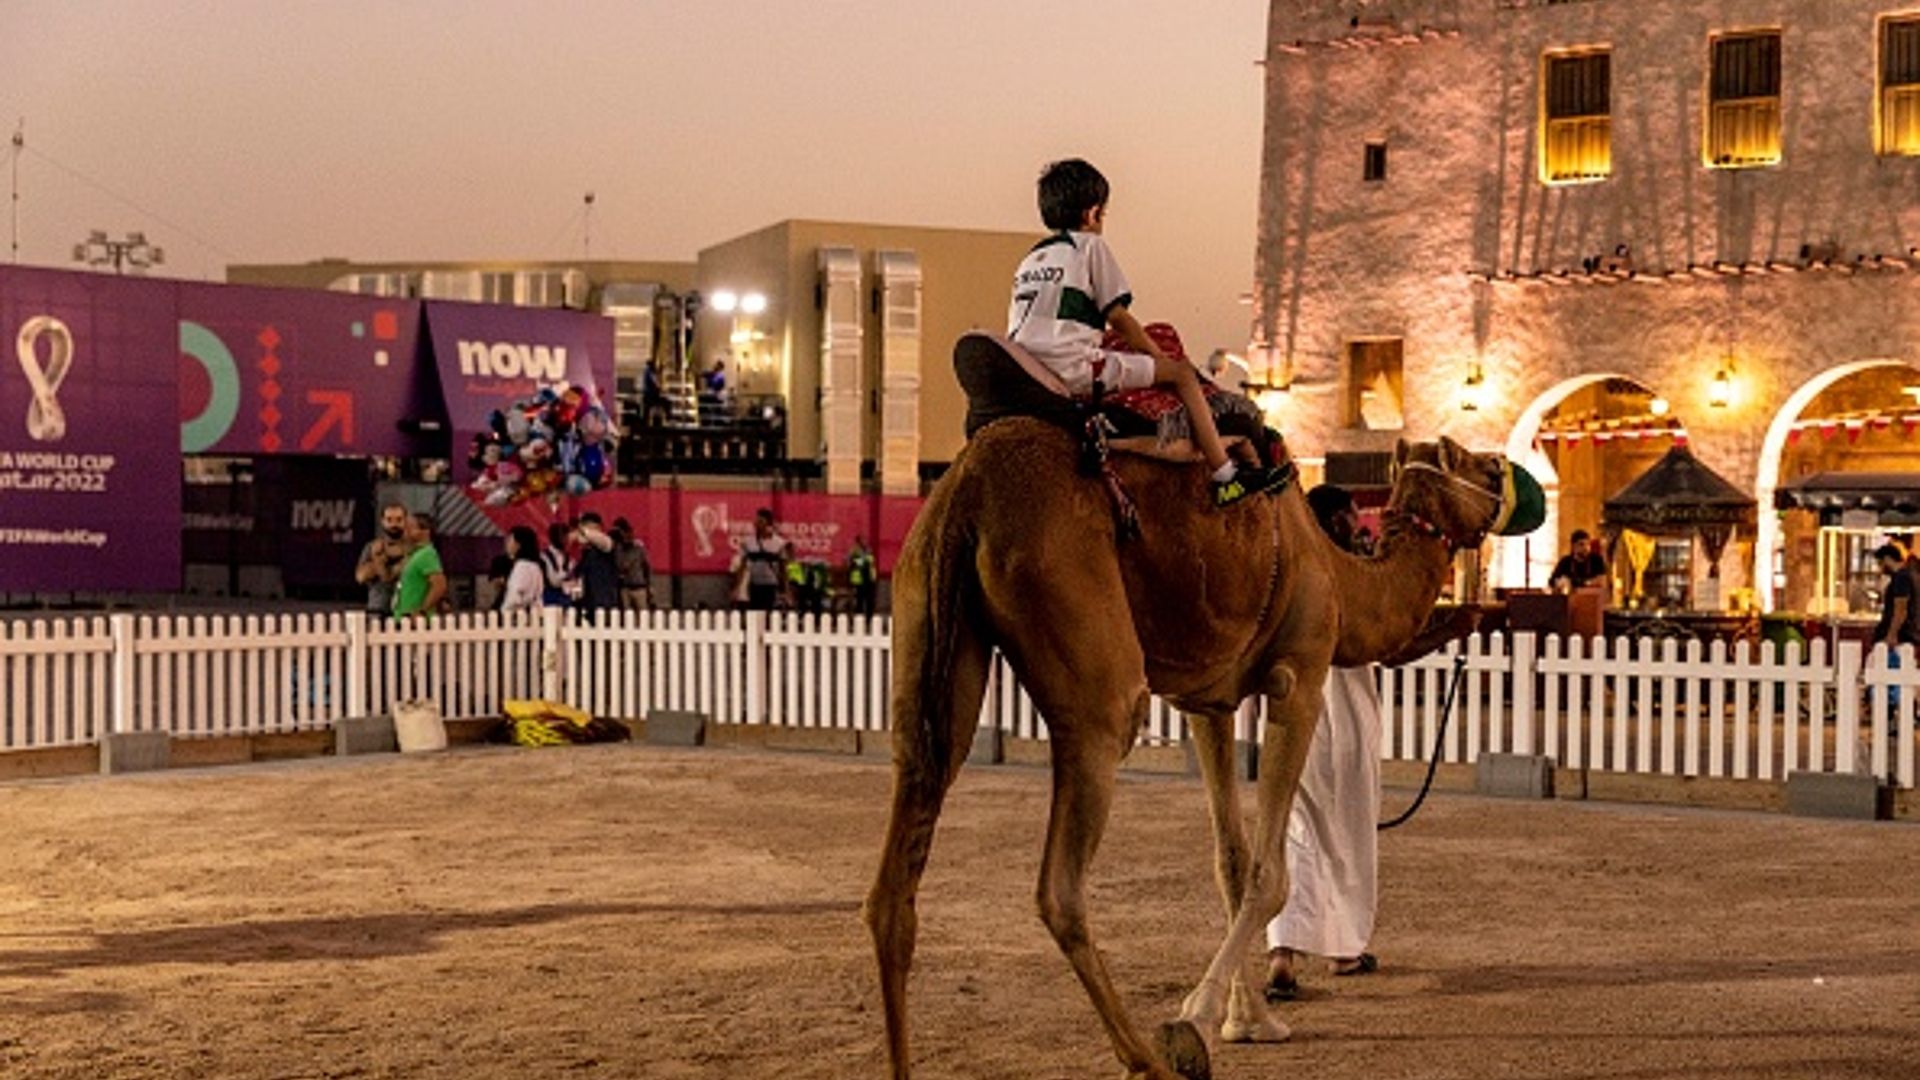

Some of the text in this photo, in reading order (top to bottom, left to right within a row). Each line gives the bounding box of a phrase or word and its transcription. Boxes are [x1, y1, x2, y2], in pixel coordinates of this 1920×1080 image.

[1008, 289, 1039, 342] 7
[457, 339, 567, 381] now
[16, 452, 79, 470] WORLD
[80, 454, 114, 471] CUP
[291, 499, 356, 530] now
